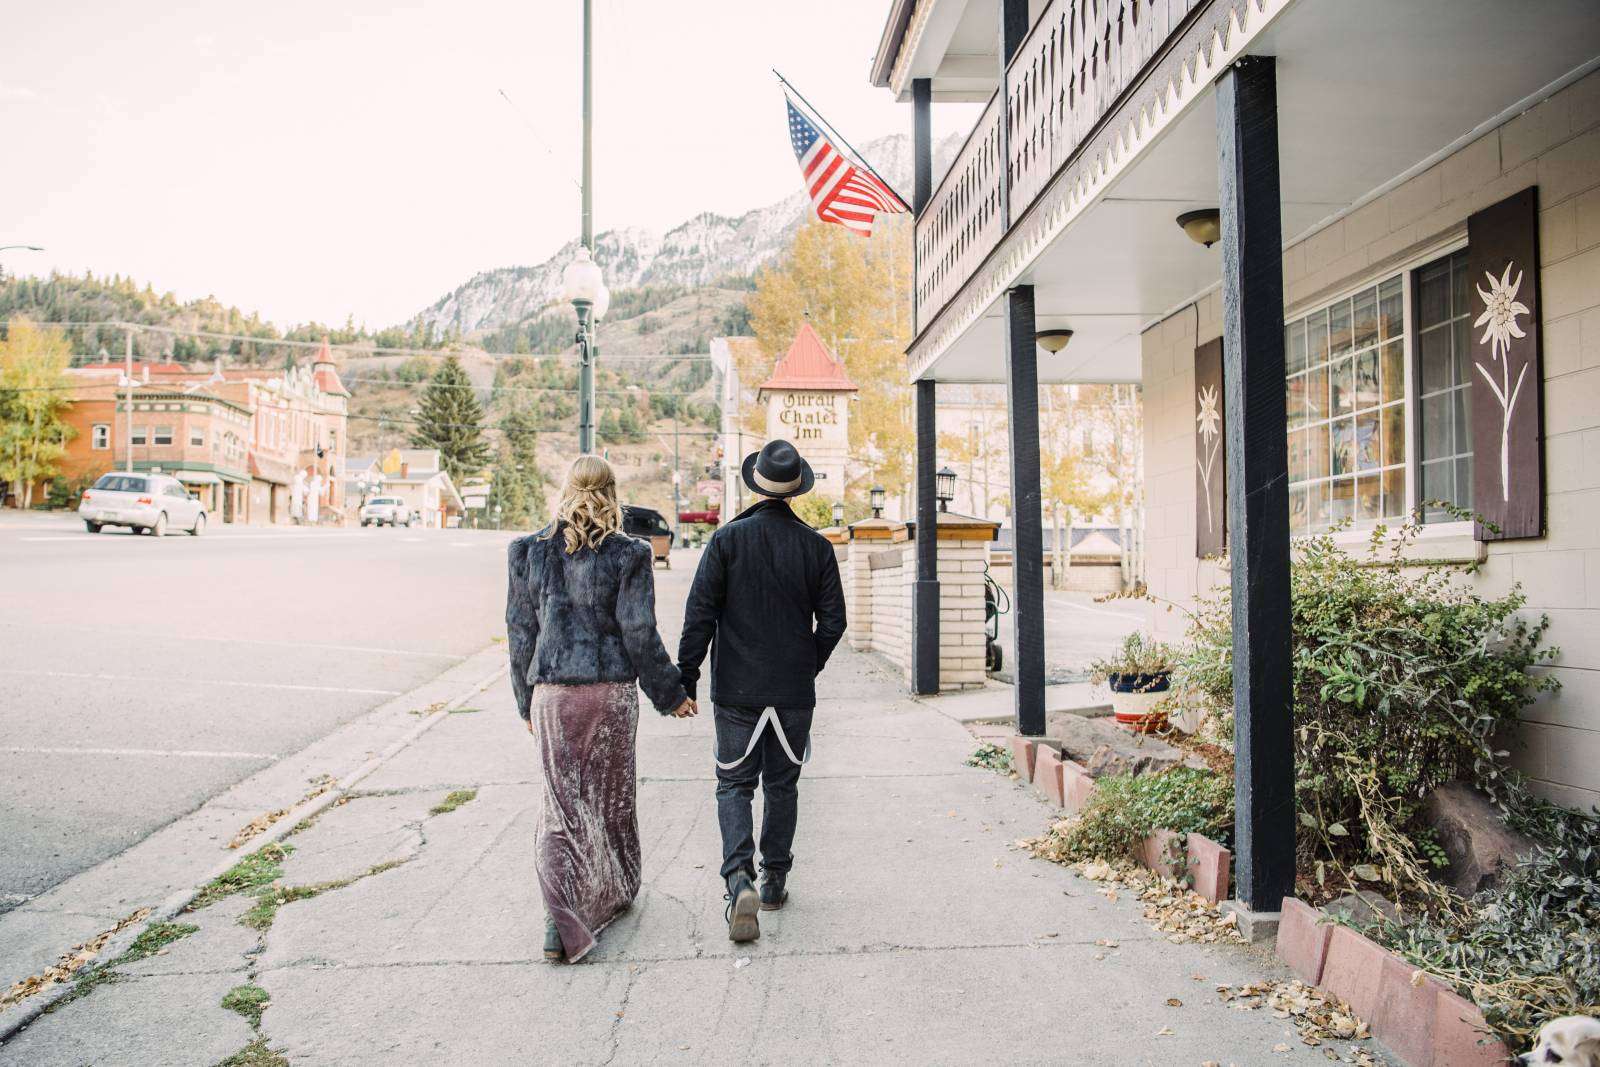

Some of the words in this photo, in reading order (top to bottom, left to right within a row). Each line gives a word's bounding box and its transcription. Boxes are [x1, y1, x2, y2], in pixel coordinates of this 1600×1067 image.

[783, 393, 835, 412] Ouray
[780, 409, 837, 424] Chalet
[793, 426, 822, 439] Inn
